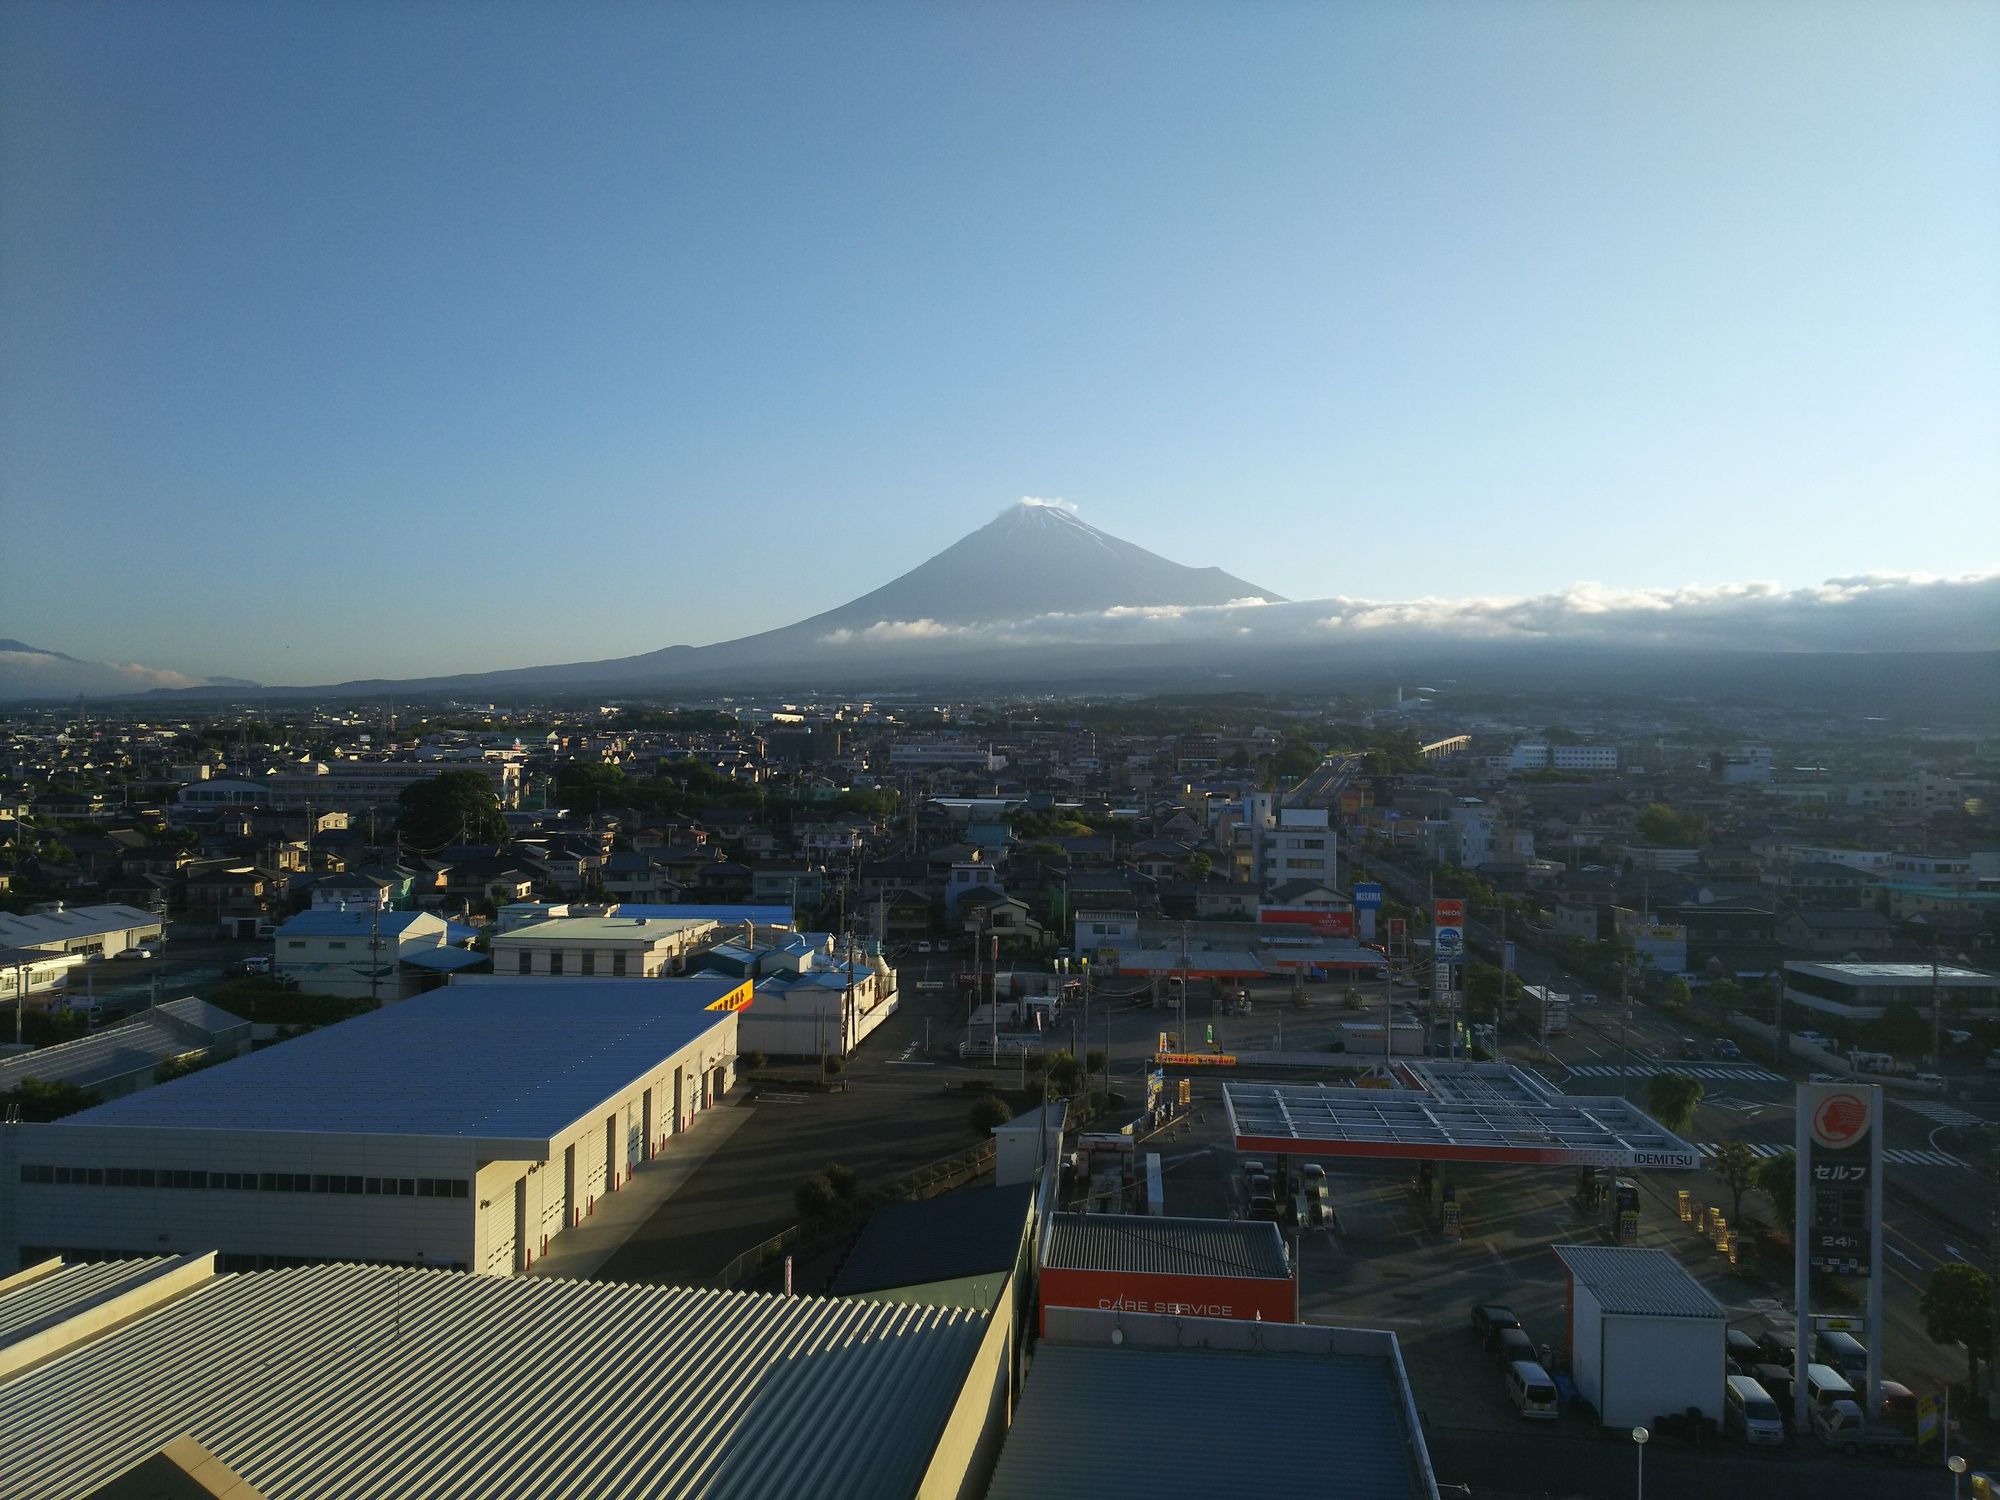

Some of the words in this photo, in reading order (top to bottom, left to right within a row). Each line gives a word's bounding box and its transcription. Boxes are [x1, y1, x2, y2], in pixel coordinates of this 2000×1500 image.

[1355, 892, 1381, 901] MISAWA
[1634, 1153, 1692, 1166] IDEMITSU
[1814, 1164, 1866, 1181] セルフ
[1821, 1235, 1858, 1247] 24h
[1098, 1298, 1148, 1312] CARE
[1154, 1301, 1233, 1316] SERVICE
